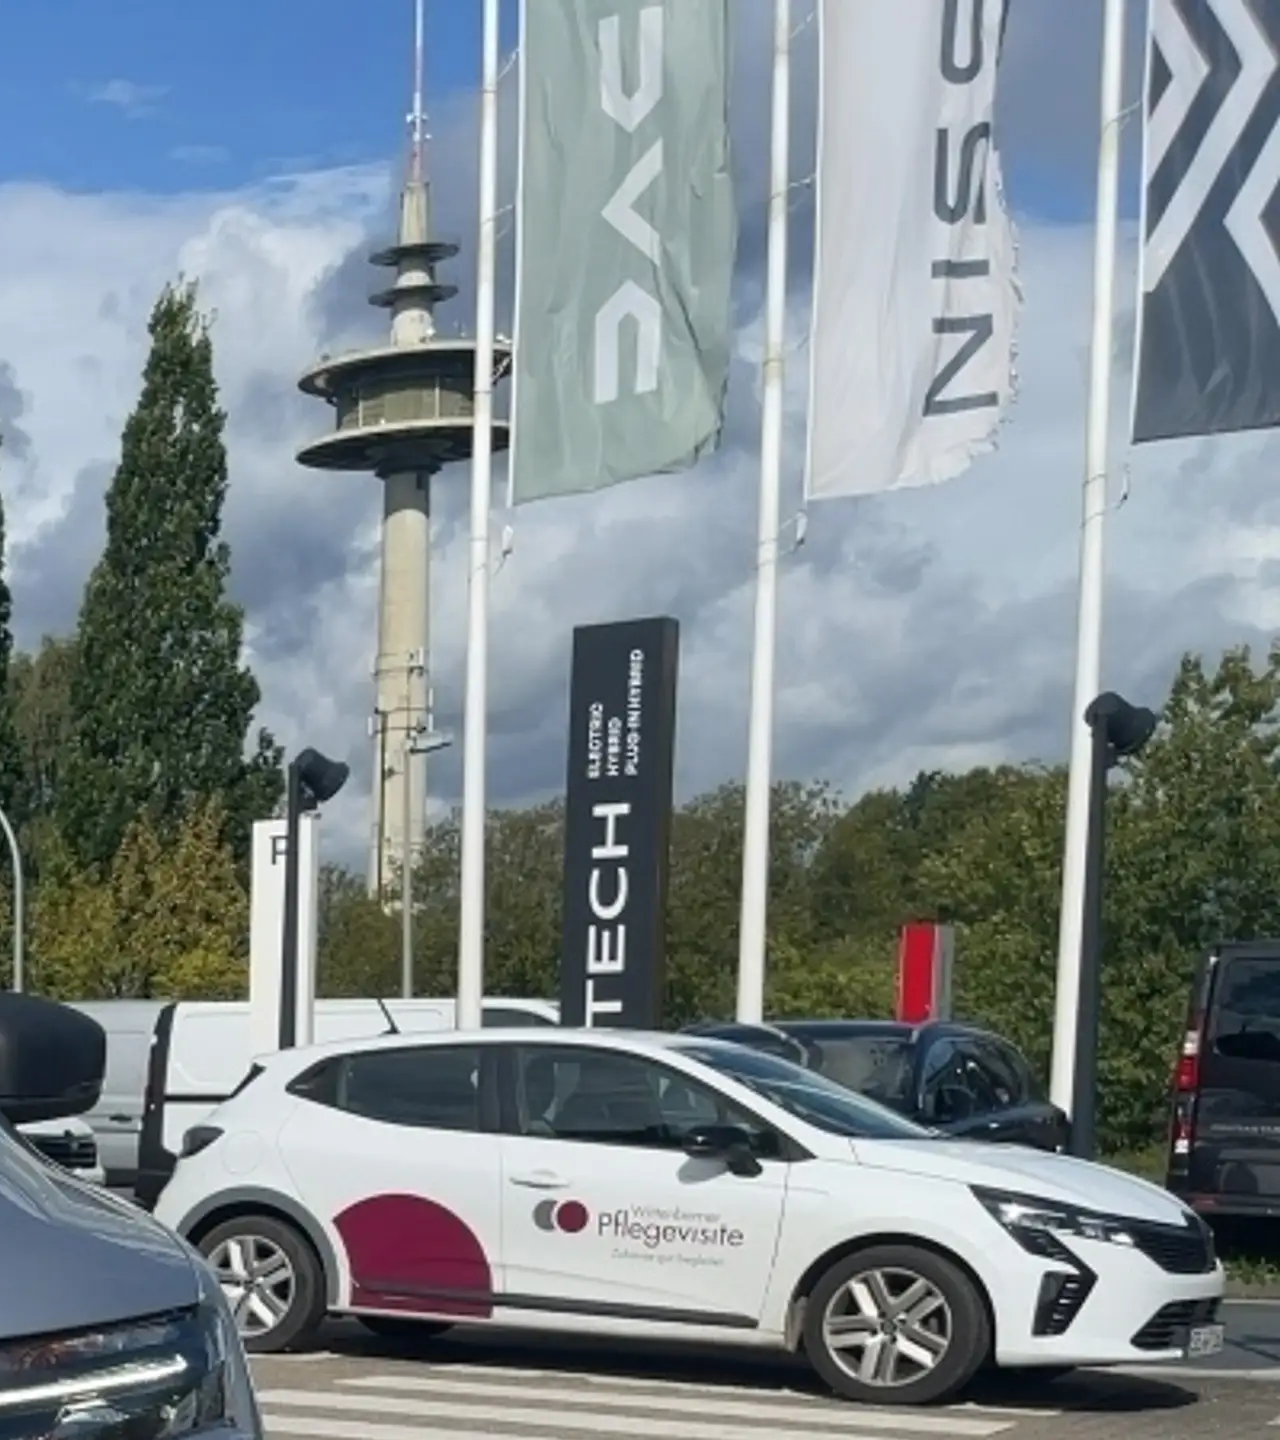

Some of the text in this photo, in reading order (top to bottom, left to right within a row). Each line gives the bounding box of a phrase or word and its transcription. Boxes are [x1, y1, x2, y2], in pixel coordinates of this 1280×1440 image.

[626, 648, 645, 710] HYBRID
[586, 702, 604, 779] ELECTRIC
[605, 716, 622, 777] HYBRID
[585, 803, 632, 1029] TECH
[597, 1209, 744, 1249] Pflegevisite
